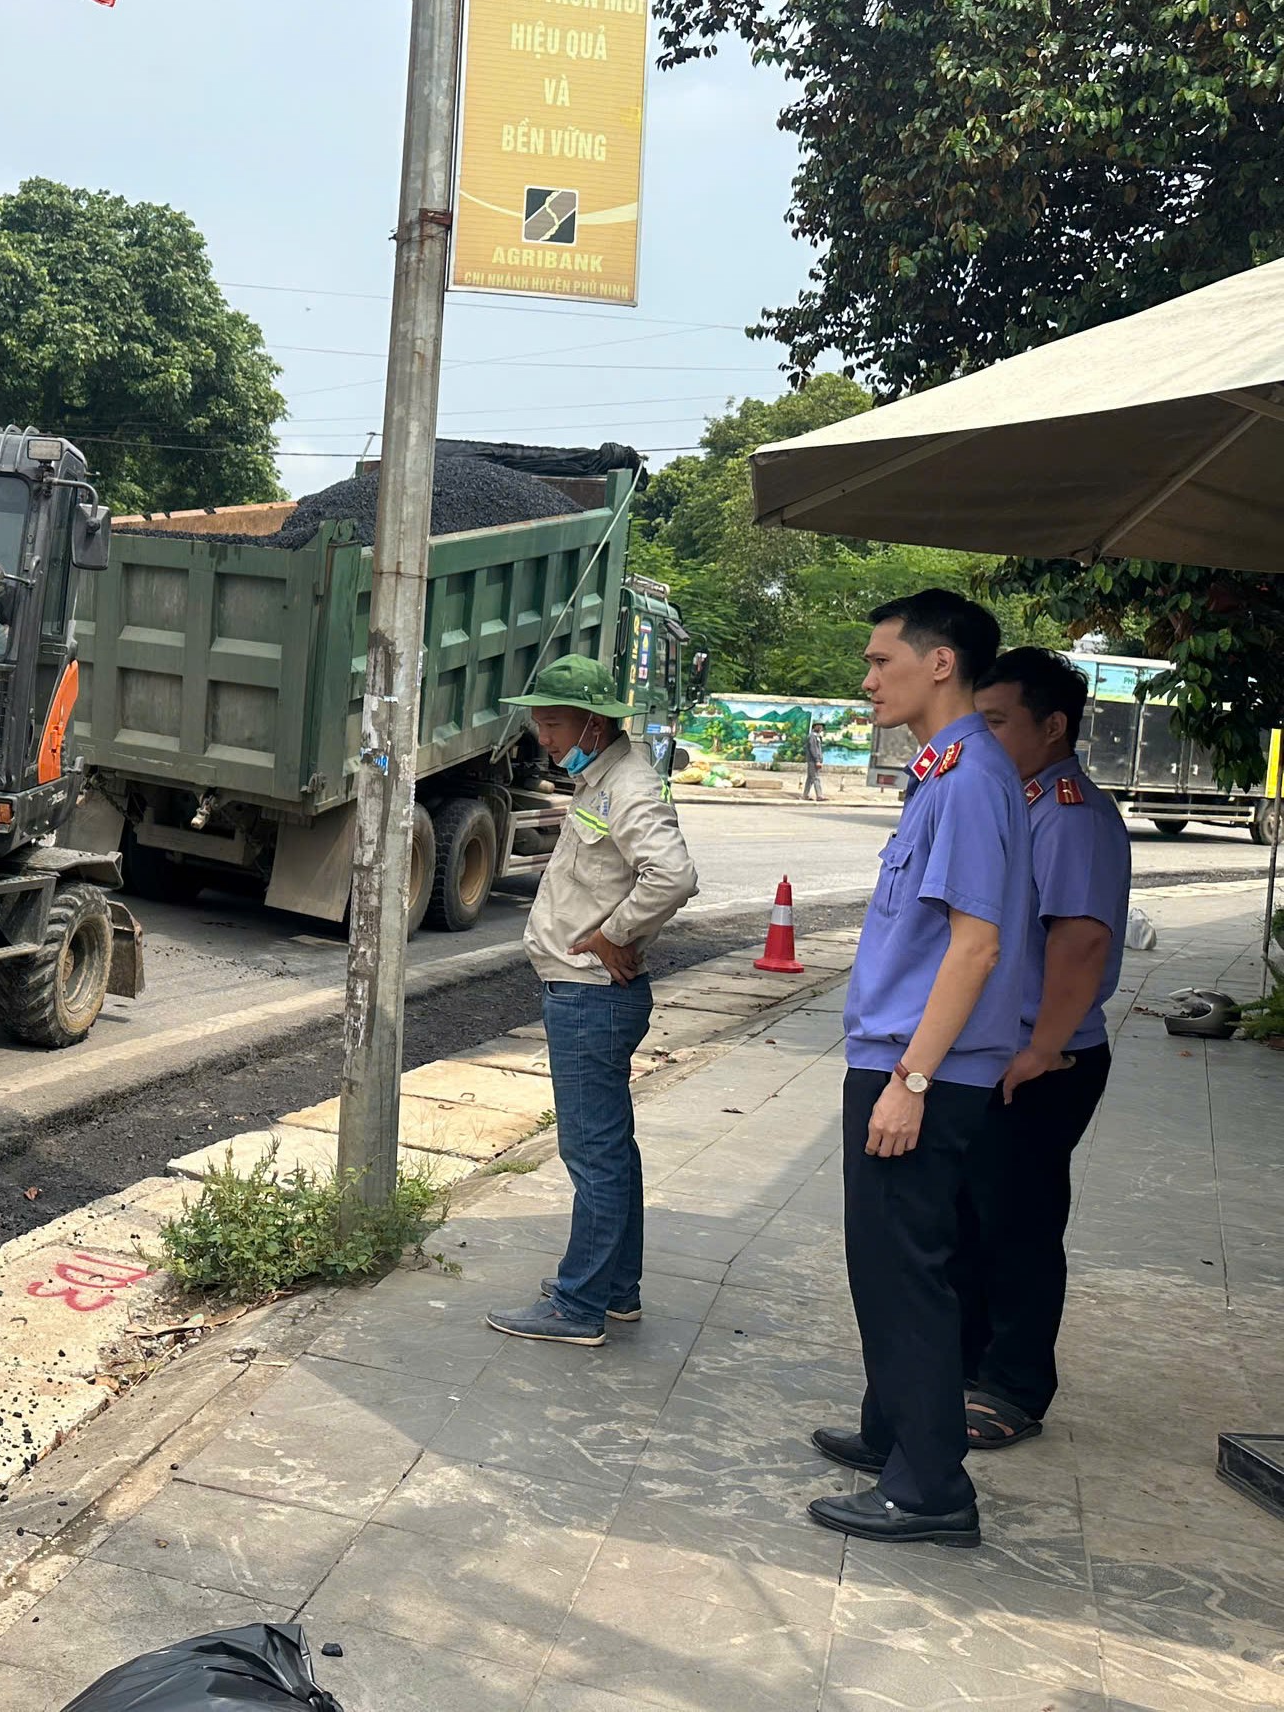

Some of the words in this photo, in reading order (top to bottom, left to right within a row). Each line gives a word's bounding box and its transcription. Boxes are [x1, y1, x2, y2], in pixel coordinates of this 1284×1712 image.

[511, 20, 560, 59] HIỆU
[566, 24, 607, 61] QUẢ
[544, 74, 570, 107] VÀ
[501, 117, 545, 155] BỀN
[550, 126, 607, 161] VỮNG
[491, 246, 604, 273] AGRIBANK
[464, 271, 484, 285] CHI
[487, 272, 529, 289] NHÁNH
[599, 282, 629, 297] NINH
